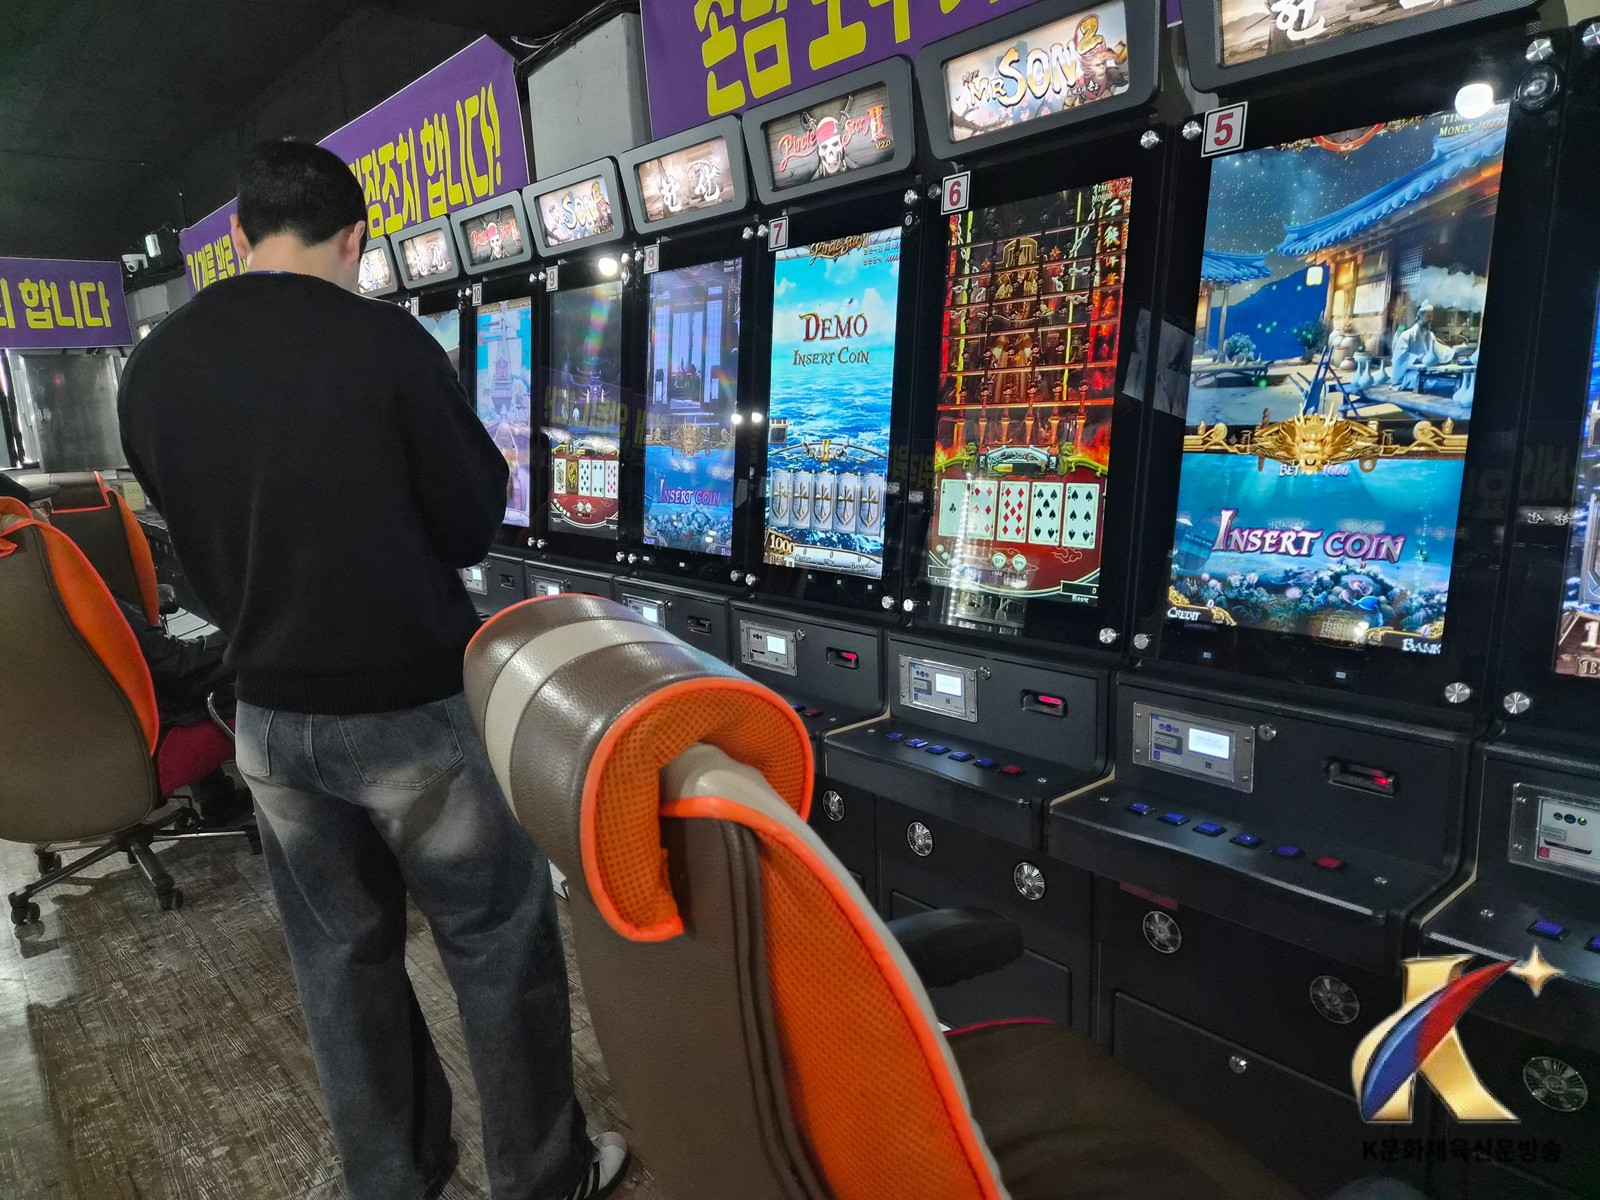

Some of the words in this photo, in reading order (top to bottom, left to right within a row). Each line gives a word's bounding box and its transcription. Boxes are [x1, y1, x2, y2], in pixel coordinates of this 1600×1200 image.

[998, 41, 1079, 108] SON
[1212, 112, 1235, 147] 5
[1439, 122, 1474, 137] MONEY
[419, 82, 502, 219] 합니다!
[947, 180, 962, 207] 6
[773, 222, 783, 245] 7
[646, 251, 655, 269] 8
[548, 272, 556, 288] 9
[18, 278, 113, 330] 합니다
[473, 288, 481, 302] 10
[798, 311, 869, 343] DEMO
[792, 348, 836, 367] INSERT
[838, 346, 870, 366] COIN
[658, 478, 695, 505] INSERT
[695, 489, 721, 507] COIN
[769, 534, 796, 554] 1000
[1211, 508, 1324, 556] INSERT
[1323, 531, 1408, 564] COIN
[1166, 606, 1201, 621] CREDIT
[1401, 637, 1442, 655] BANK
